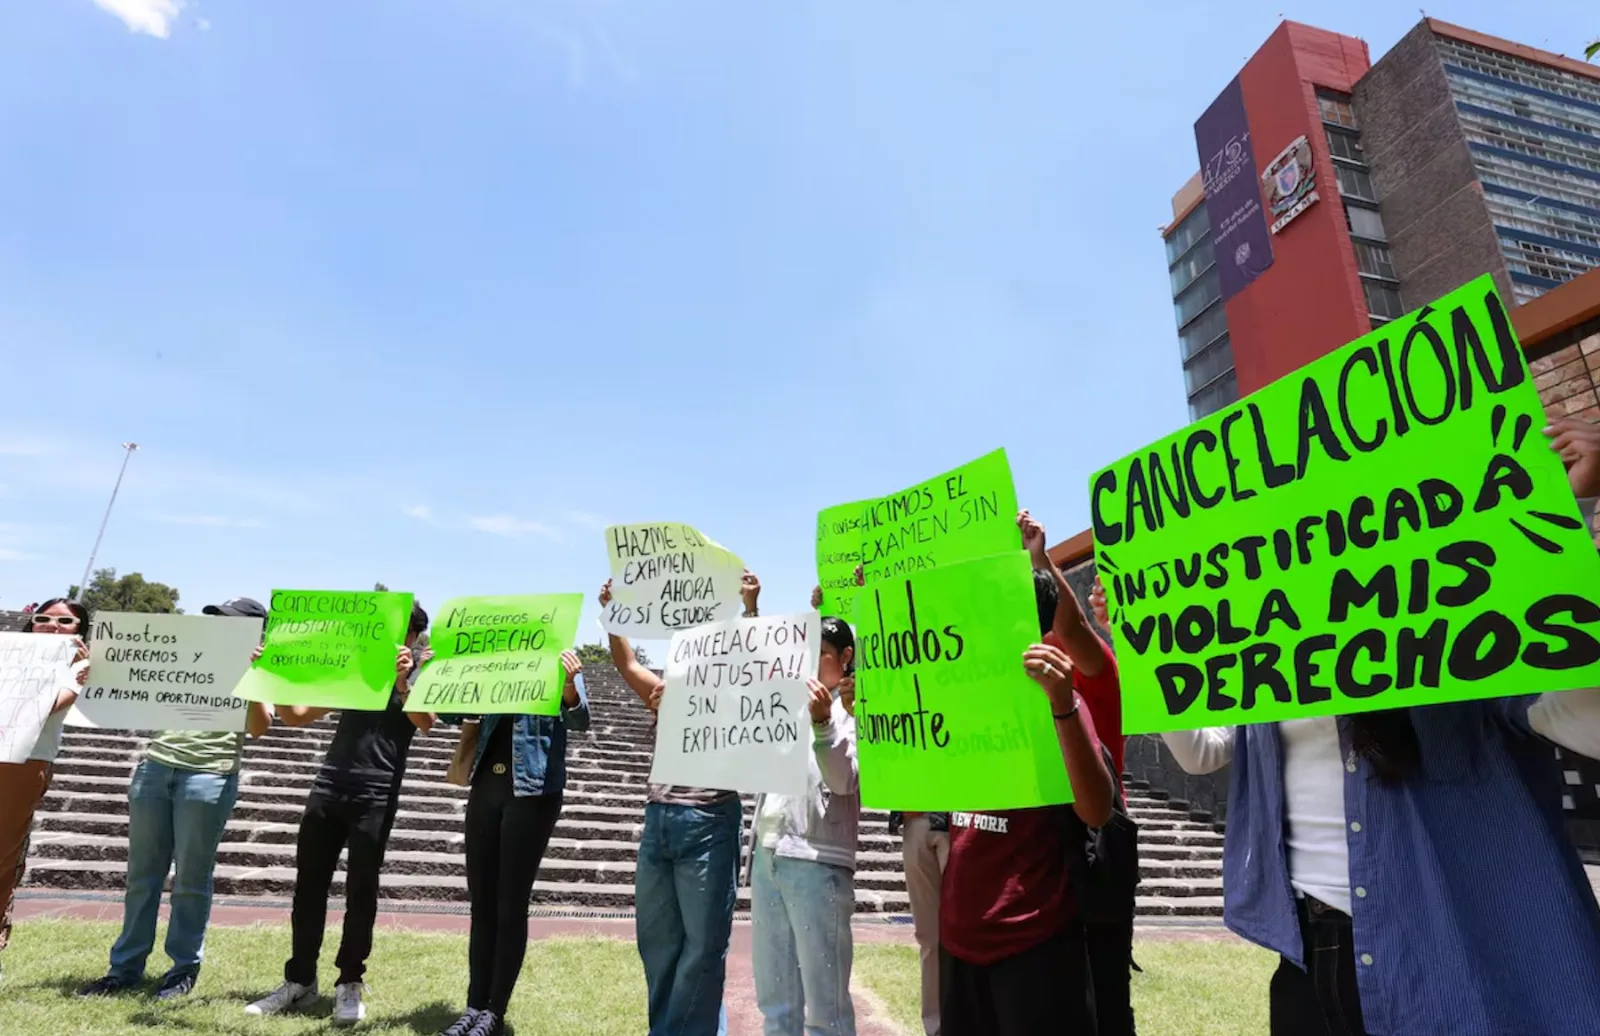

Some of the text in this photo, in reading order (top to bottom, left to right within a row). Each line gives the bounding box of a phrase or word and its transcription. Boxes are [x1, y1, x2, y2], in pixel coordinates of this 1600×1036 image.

[1274, 194, 1312, 230] UNAM
[1092, 290, 1525, 546] CANCELACIÓN
[860, 487, 934, 535] HICIMOS
[945, 474, 968, 500] EL
[614, 526, 676, 559] HAZME
[861, 509, 948, 565] EXAMEN
[958, 491, 998, 530] SIN
[1112, 454, 1533, 606] INJUSTIFICADA
[624, 552, 694, 585] EXAMEN
[271, 592, 377, 616] Cancelados
[660, 577, 715, 602] AHORA
[1121, 540, 1497, 655] VIOLA MIS
[447, 608, 557, 628] Merecemos el
[609, 602, 632, 624] YO
[105, 648, 178, 663] QUEREMOS
[453, 629, 547, 655] DERECHO
[674, 621, 807, 663] CANCELACIÓN
[1155, 594, 1600, 715] DERECHOS
[129, 668, 215, 684] MERECEMOS
[436, 657, 542, 679] de presentar el
[687, 654, 804, 688] INJUSTA!!
[85, 687, 102, 699] LA
[108, 688, 149, 702] MISMA
[490, 680, 549, 704] CONTROL
[687, 692, 790, 722] SIN DAR
[952, 811, 1009, 833] NEW YORK
